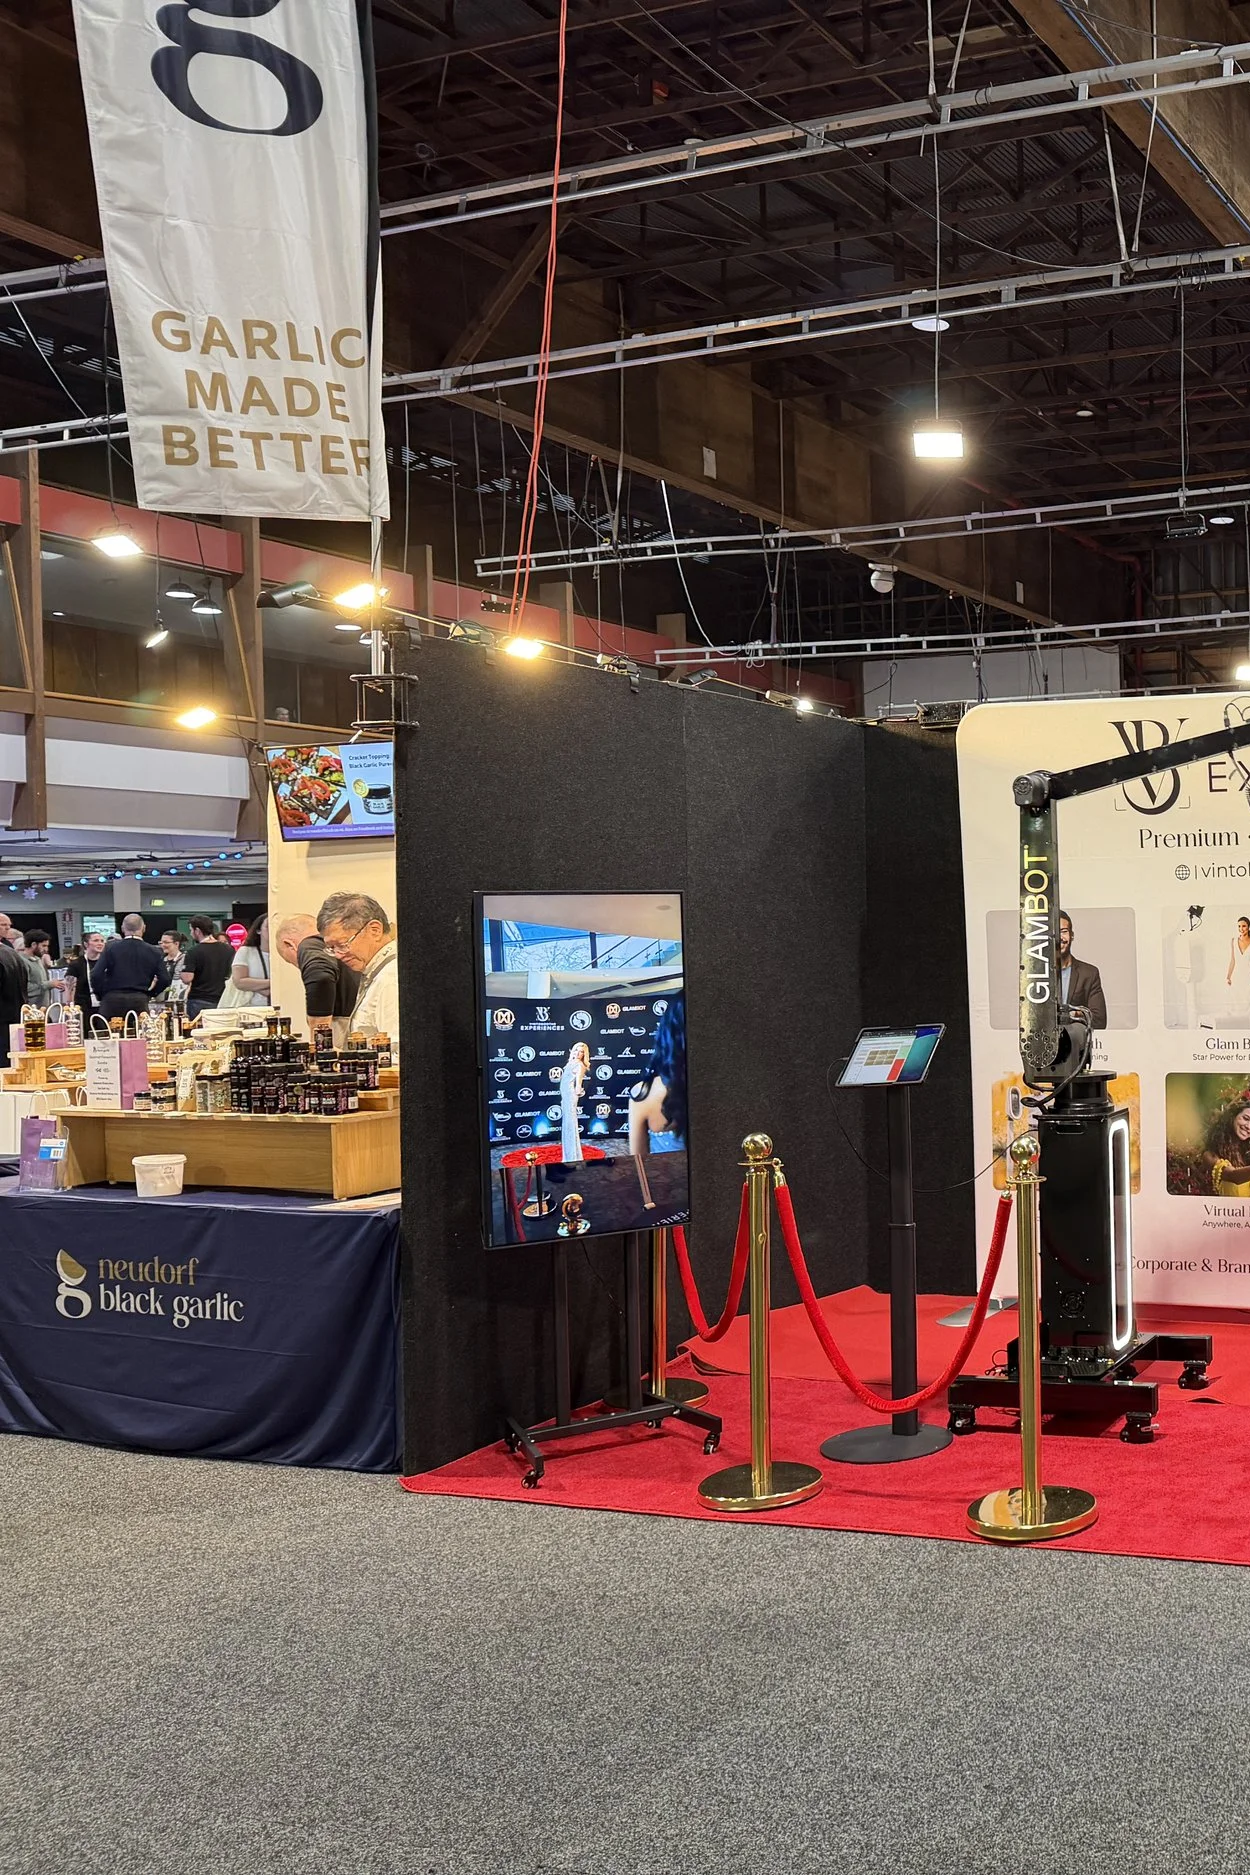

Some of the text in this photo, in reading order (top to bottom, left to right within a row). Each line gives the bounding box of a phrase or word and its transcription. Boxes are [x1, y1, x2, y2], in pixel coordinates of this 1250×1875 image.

[152, 310, 366, 369] GARLIC
[184, 369, 350, 423] MADE
[162, 425, 371, 477] BETTER
[1138, 828, 1239, 849] Premium
[1024, 849, 1050, 1004] GLAMBOT
[1193, 1053, 1207, 1061] Star
[1210, 1053, 1234, 1061] Power
[1236, 1053, 1246, 1061] for
[1205, 1038, 1239, 1050] Glam
[1204, 1204, 1245, 1217] Virtual
[1202, 1220, 1243, 1229] Anywhere,
[99, 1255, 199, 1286] neudorf
[1201, 1258, 1213, 1272] &
[99, 1283, 245, 1329] black garlic
